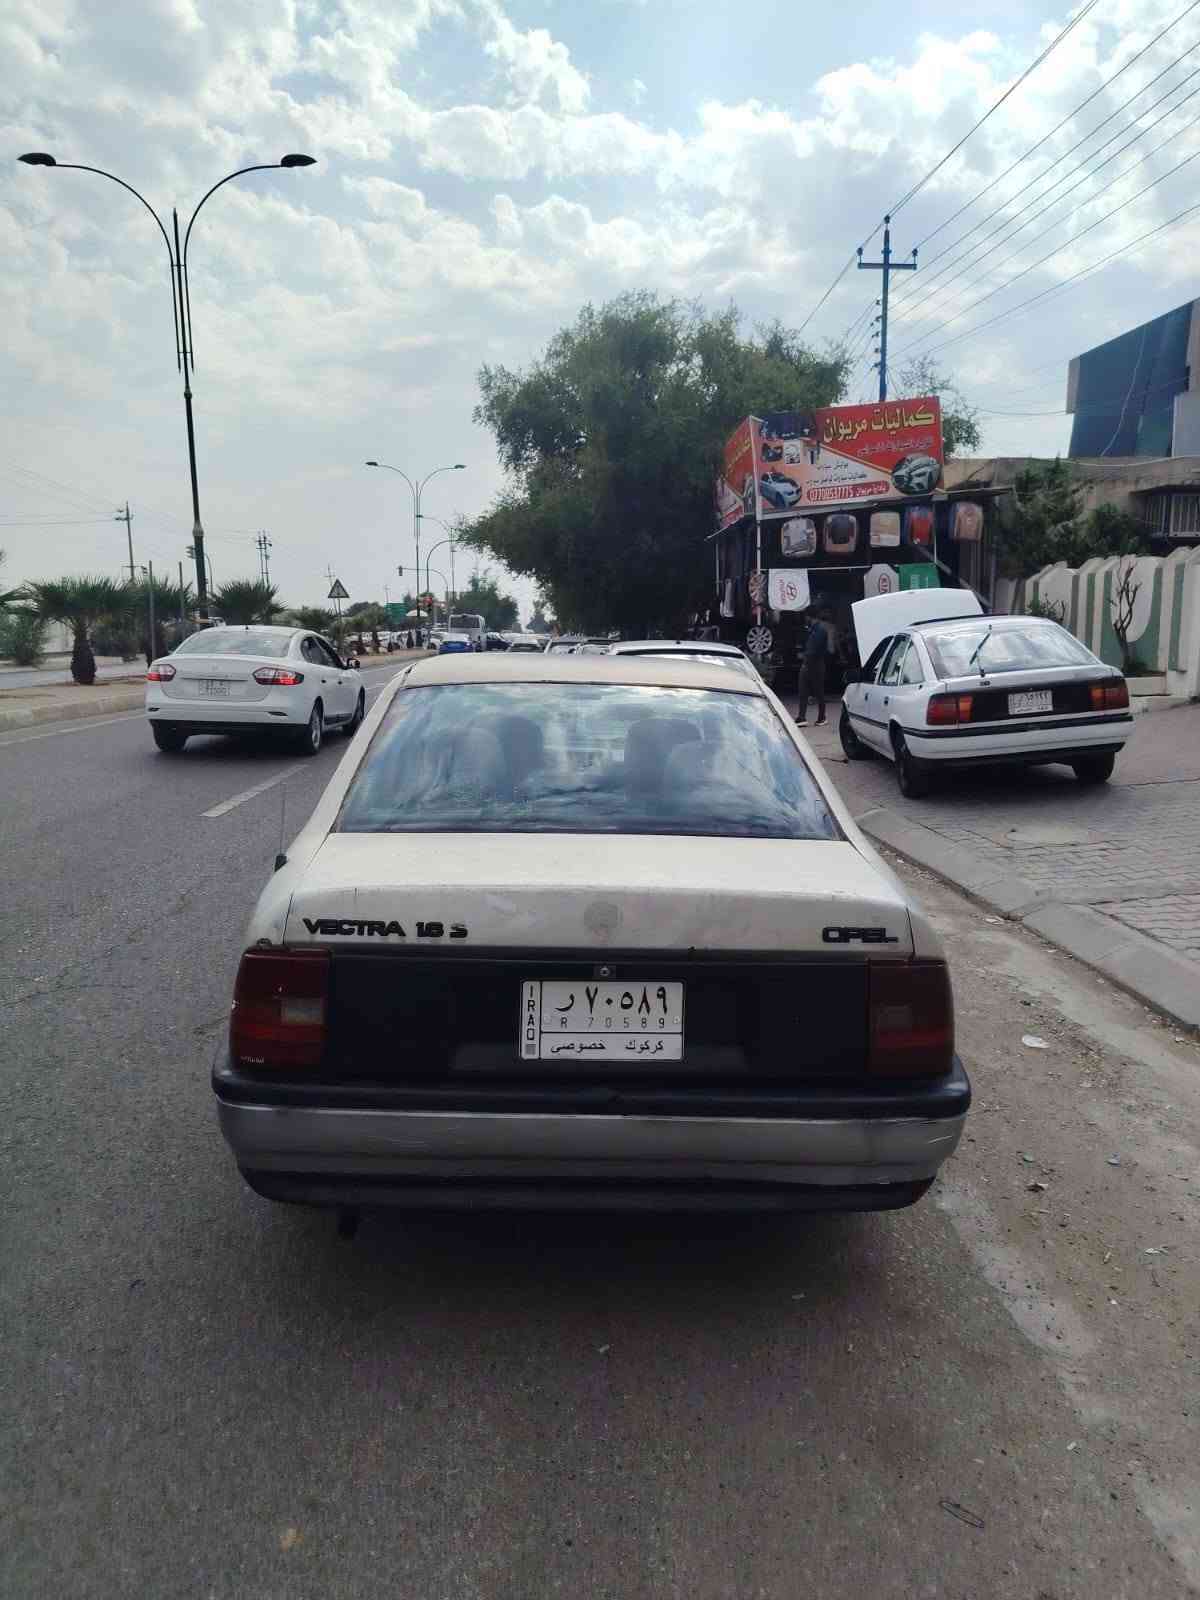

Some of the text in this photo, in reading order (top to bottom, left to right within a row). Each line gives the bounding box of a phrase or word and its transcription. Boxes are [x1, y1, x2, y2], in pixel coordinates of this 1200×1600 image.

[823, 402, 936, 443] كماليات مريوان
[302, 918, 406, 937] VECTRA
[449, 923, 468, 939] S
[822, 926, 899, 943] OPEL
[624, 1039, 664, 1054] كركوك
